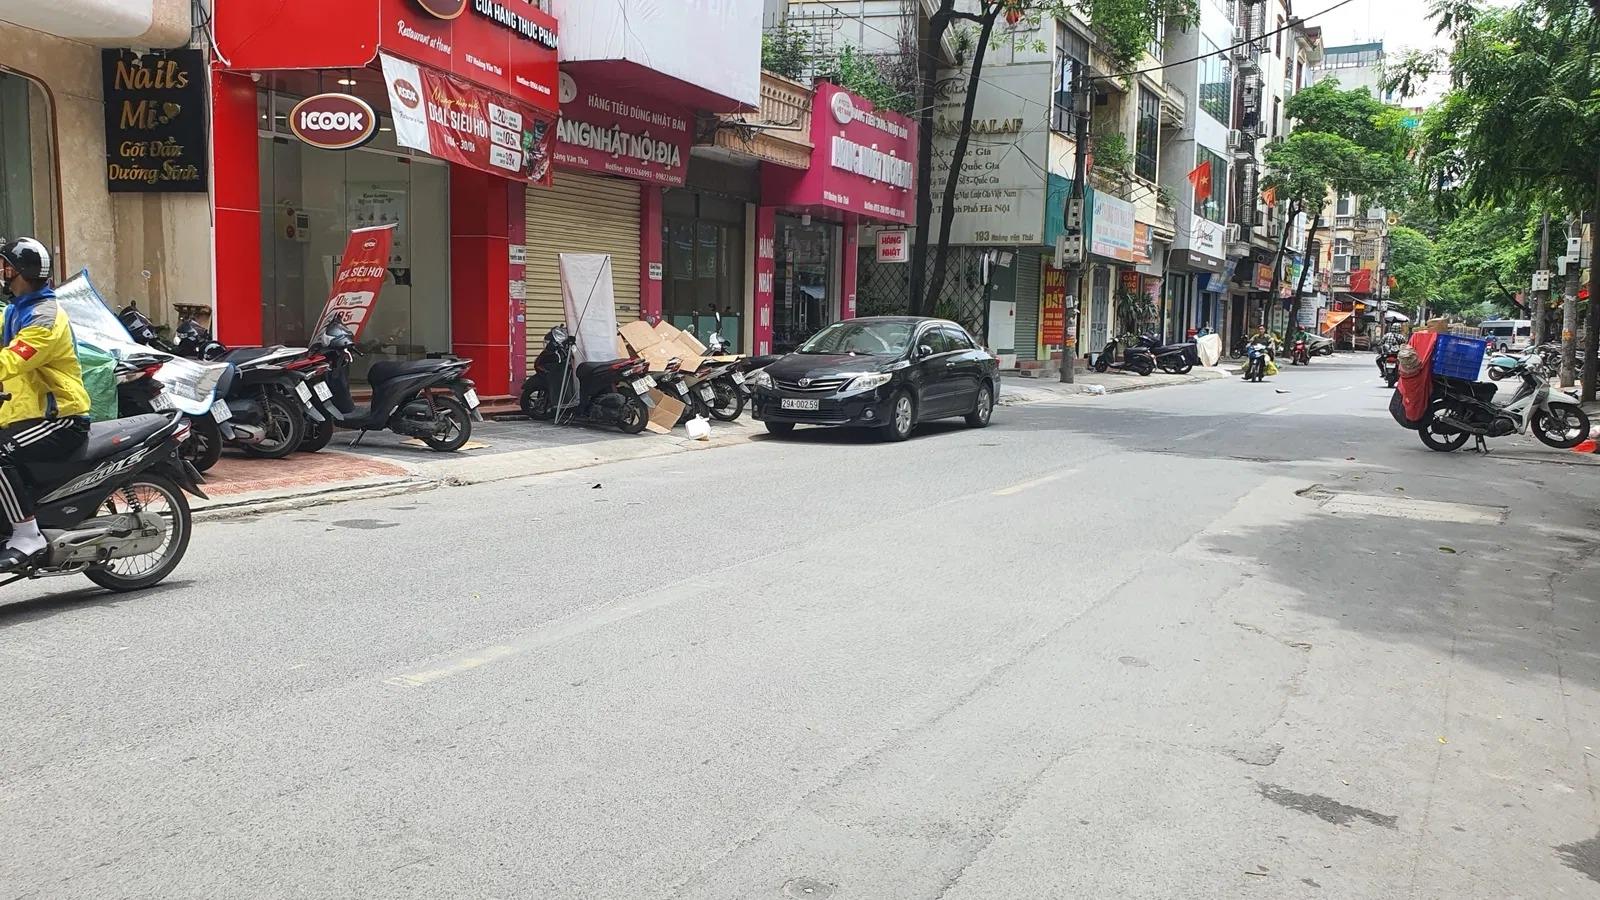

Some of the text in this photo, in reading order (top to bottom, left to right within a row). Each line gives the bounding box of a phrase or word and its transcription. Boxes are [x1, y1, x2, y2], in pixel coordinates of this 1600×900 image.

[494, 3, 517, 29] HÀNG
[518, 15, 538, 40] THỰC
[397, 19, 430, 45] Restaurant
[436, 36, 451, 55] Home
[114, 60, 189, 90] Nails
[588, 93, 687, 132] HÀNG TIÊU DÙNG NHẬT BẢN
[631, 130, 656, 165] NỘI
[656, 141, 681, 171] ĐỊA
[975, 147, 992, 156] Gia
[109, 163, 159, 184] Dưỡng
[960, 161, 983, 171] Quốc
[963, 203, 978, 213] Phố
[881, 235, 902, 245] HÀNG
[975, 231, 990, 241] 193
[881, 245, 901, 257] NHẬT
